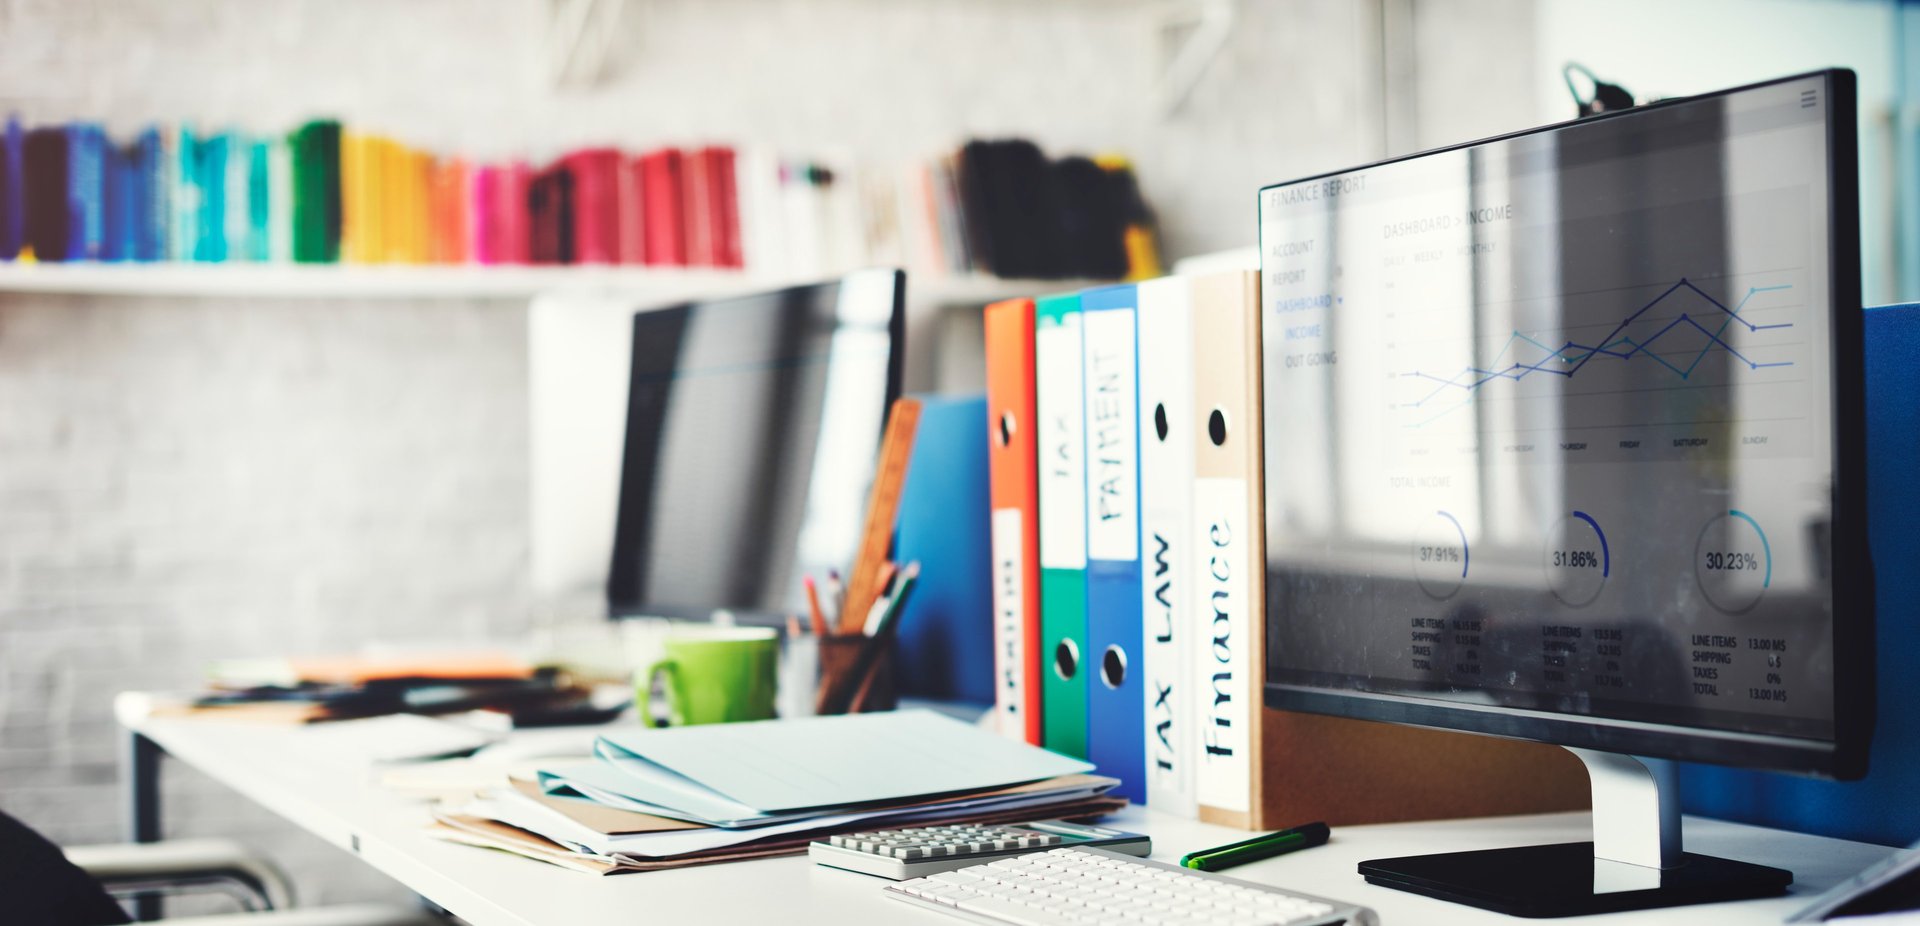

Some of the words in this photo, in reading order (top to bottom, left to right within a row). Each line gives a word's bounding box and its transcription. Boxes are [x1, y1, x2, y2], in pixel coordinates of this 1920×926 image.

[1271, 184, 1318, 207] FINANCE
[1322, 175, 1366, 197] REPORT
[1383, 215, 1450, 240] DASHBOARD
[1466, 204, 1512, 225] INCOME
[1272, 240, 1314, 258] ACCOUNT
[1456, 242, 1496, 256] MONTHLY
[1272, 269, 1306, 286] REPORT
[1276, 294, 1332, 313] DASHBOARD
[1286, 325, 1321, 340] INCOME
[1285, 354, 1304, 368] OUT
[1306, 351, 1337, 367] GOING
[1093, 350, 1121, 521] PAYMENT
[1619, 441, 1640, 449] FRIDAY
[1390, 476, 1414, 488] TOTAL
[1417, 475, 1451, 488] INCOME
[1420, 546, 1458, 562] 37.91%
[1553, 551, 1598, 568] 31.86%
[1706, 552, 1757, 571] 30.23%
[1153, 532, 1172, 643] LAW
[1411, 618, 1425, 628] LINE
[1426, 618, 1445, 629] ITEMS
[1542, 625, 1558, 637] LINE
[1559, 626, 1582, 638] ITEMS
[1204, 519, 1233, 764] Finance
[1411, 631, 1440, 643] SHIPPING
[1692, 634, 1710, 647] LINE
[1711, 635, 1737, 648] ITEMS
[1748, 638, 1771, 650] 13.00
[1412, 645, 1431, 656] TAXES
[1692, 650, 1732, 664] SHIPPING
[1412, 659, 1432, 670] TOTAL
[1692, 666, 1718, 680] TAXES
[1767, 672, 1781, 685] 0%
[1692, 682, 1719, 696] TOTAL
[1749, 687, 1771, 700] 13.00
[1154, 680, 1173, 774] TAX
